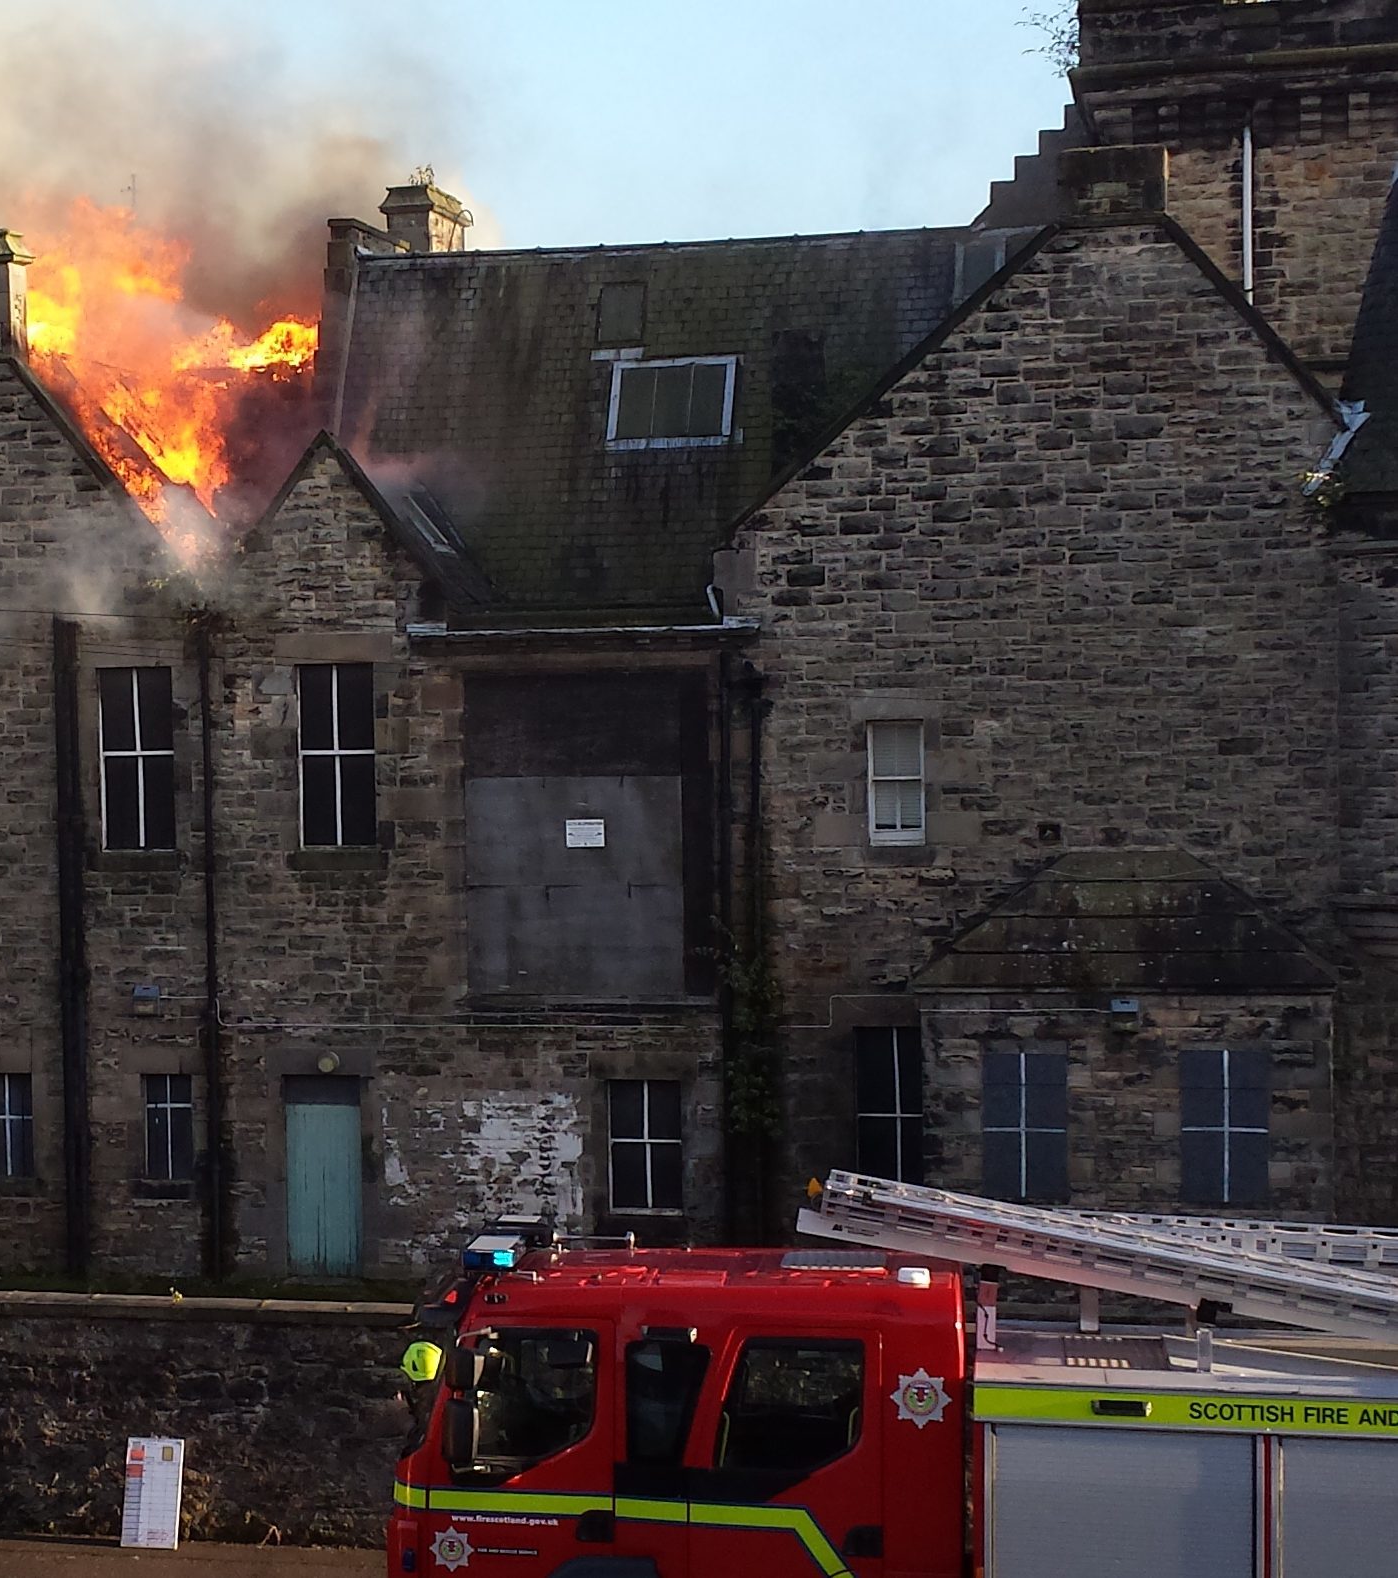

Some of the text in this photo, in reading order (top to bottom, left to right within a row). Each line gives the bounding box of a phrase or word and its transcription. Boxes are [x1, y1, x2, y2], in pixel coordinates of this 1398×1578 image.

[1189, 1402, 1398, 1427] SCOTTISH FIRE AND
